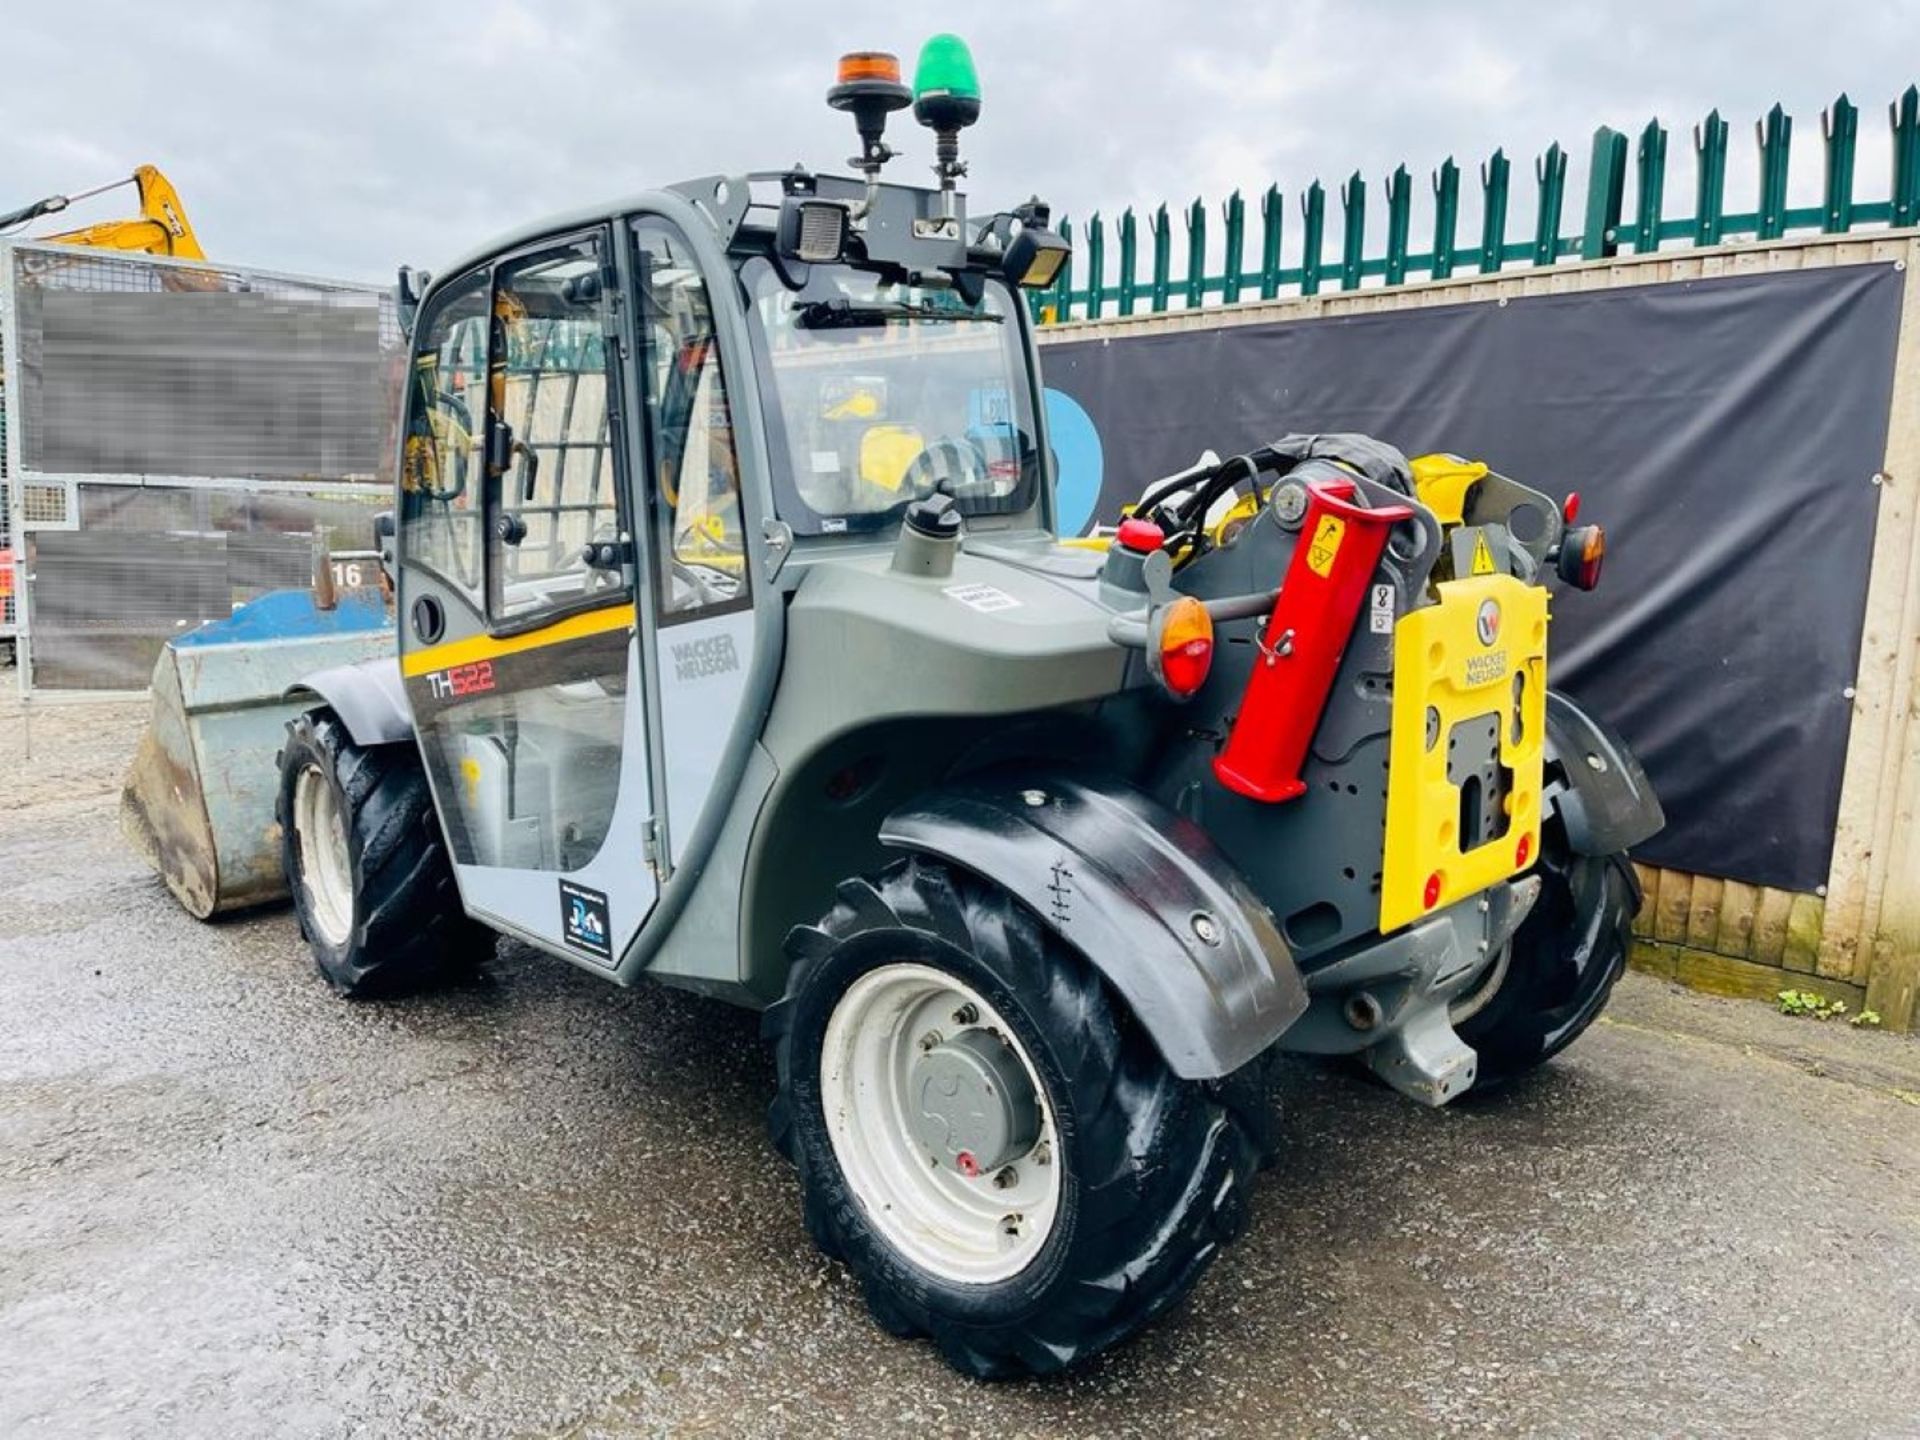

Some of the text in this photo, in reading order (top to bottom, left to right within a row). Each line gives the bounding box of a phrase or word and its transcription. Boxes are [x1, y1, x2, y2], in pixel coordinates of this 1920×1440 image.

[669, 633, 734, 662] WACKER
[425, 660, 496, 699] TH522
[675, 649, 740, 682] NEUSON
